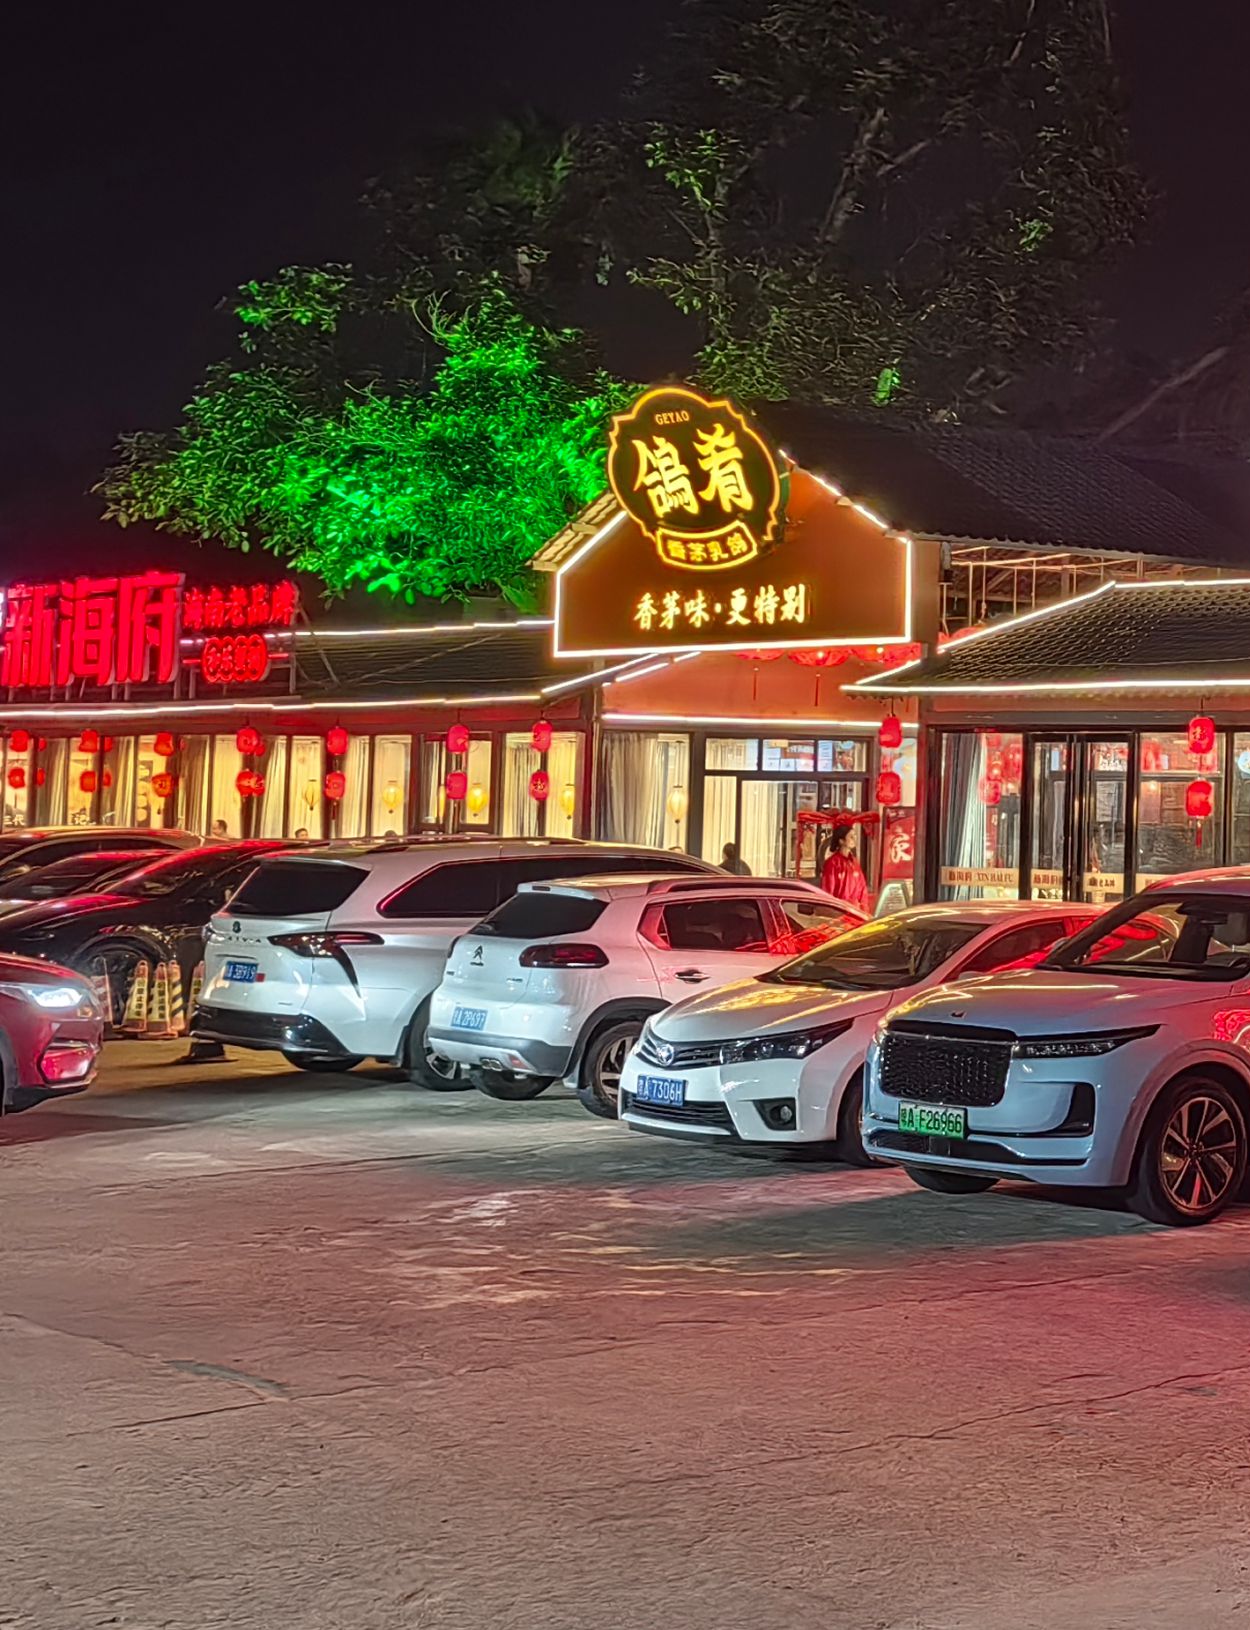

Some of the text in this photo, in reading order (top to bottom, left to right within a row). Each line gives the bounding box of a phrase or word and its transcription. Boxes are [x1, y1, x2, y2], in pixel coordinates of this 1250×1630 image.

[655, 411, 690, 425] GEYAO
[1, 571, 182, 687] 新海府
